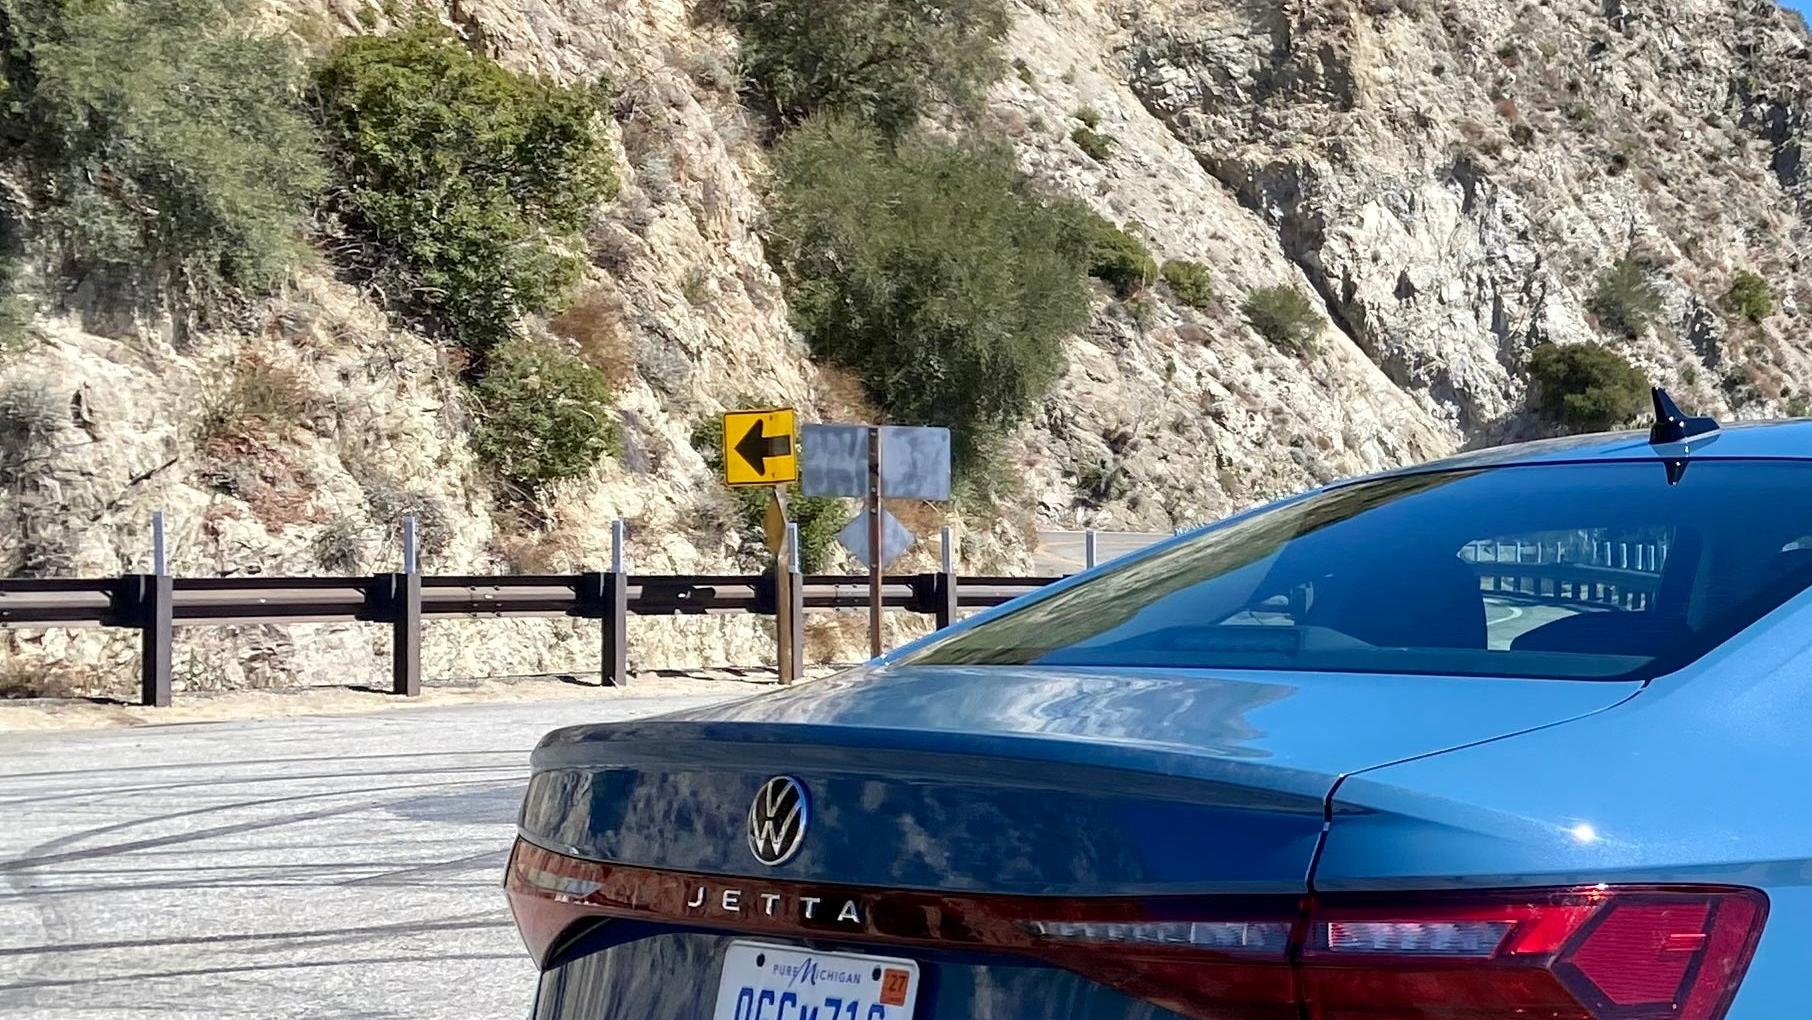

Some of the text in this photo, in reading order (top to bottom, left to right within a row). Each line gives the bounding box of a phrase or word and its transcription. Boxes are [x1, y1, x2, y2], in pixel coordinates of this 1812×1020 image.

[688, 886, 861, 924] JETTA
[773, 957, 862, 987] PURE MICHIGAN
